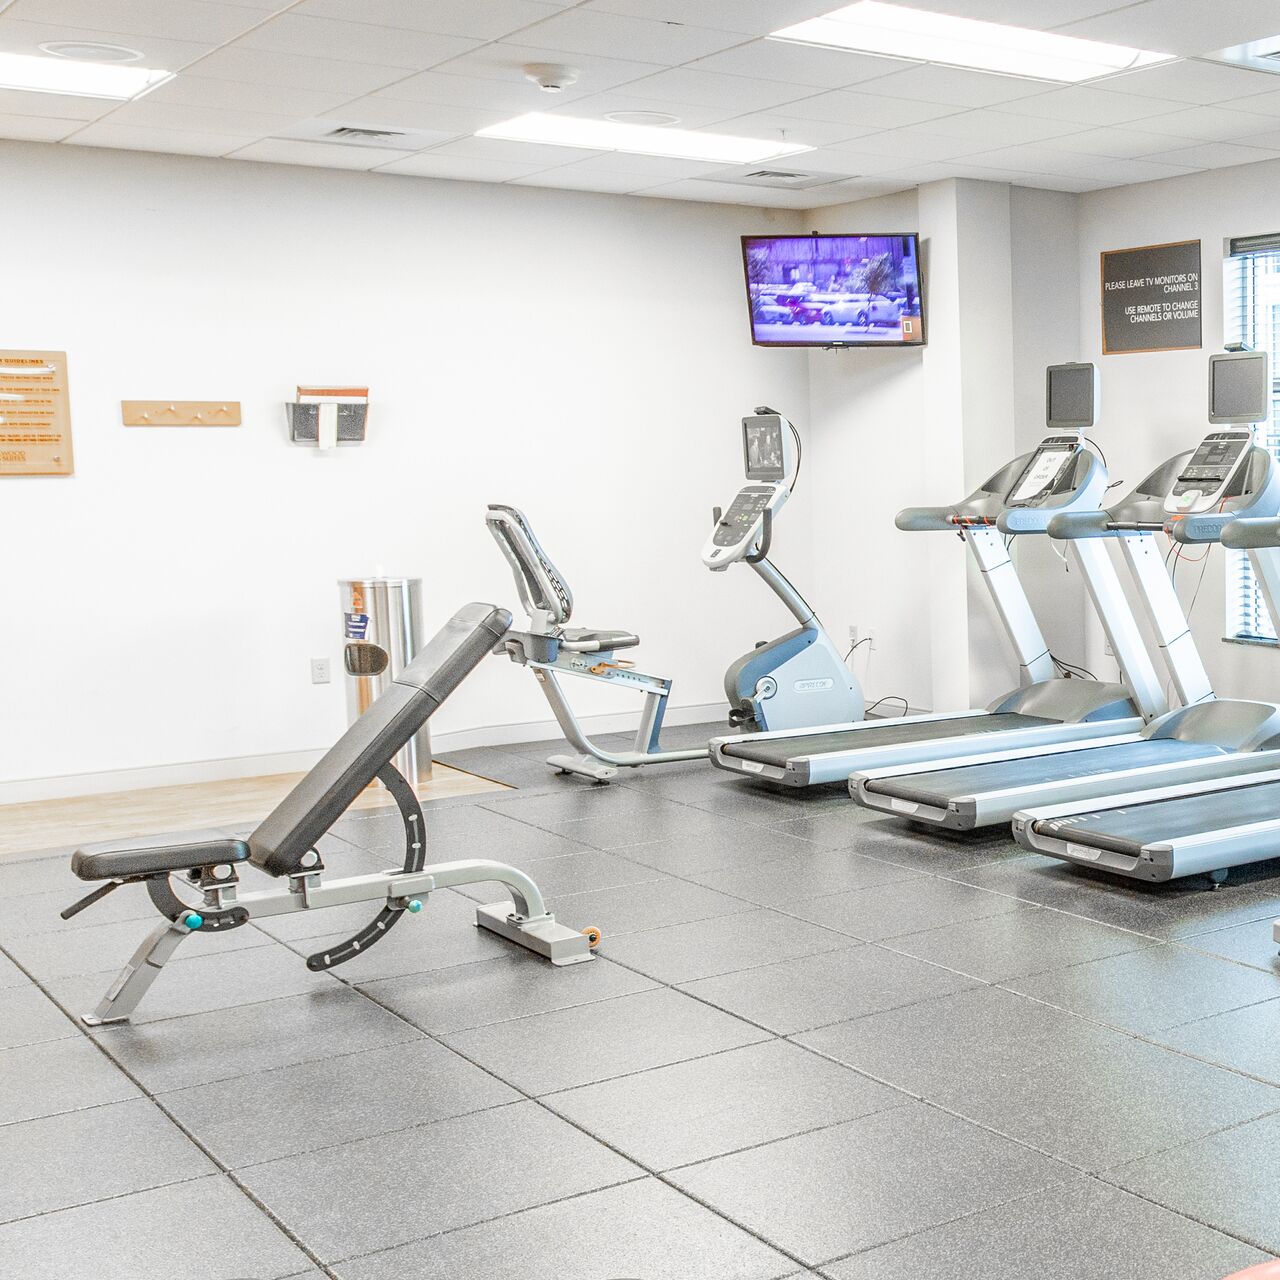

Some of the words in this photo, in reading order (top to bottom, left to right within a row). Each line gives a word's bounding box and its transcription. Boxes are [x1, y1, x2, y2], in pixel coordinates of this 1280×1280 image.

[1105, 281, 1126, 291] PLEASE
[1126, 278, 1145, 289] LEAVE
[1145, 277, 1154, 286] TV
[1154, 274, 1187, 285] MONITORS
[1187, 273, 1198, 281] ON
[1163, 283, 1193, 293] CHANNEL
[1194, 282, 1198, 290] 3
[1125, 305, 1136, 315] USE
[1137, 303, 1161, 314] REMOTE
[1162, 302, 1171, 311] TO
[1171, 300, 1198, 310] CHANGE
[1130, 312, 1162, 323] CHANNELS
[1162, 311, 1172, 320] OR
[1173, 309, 1198, 319] VOLUME
